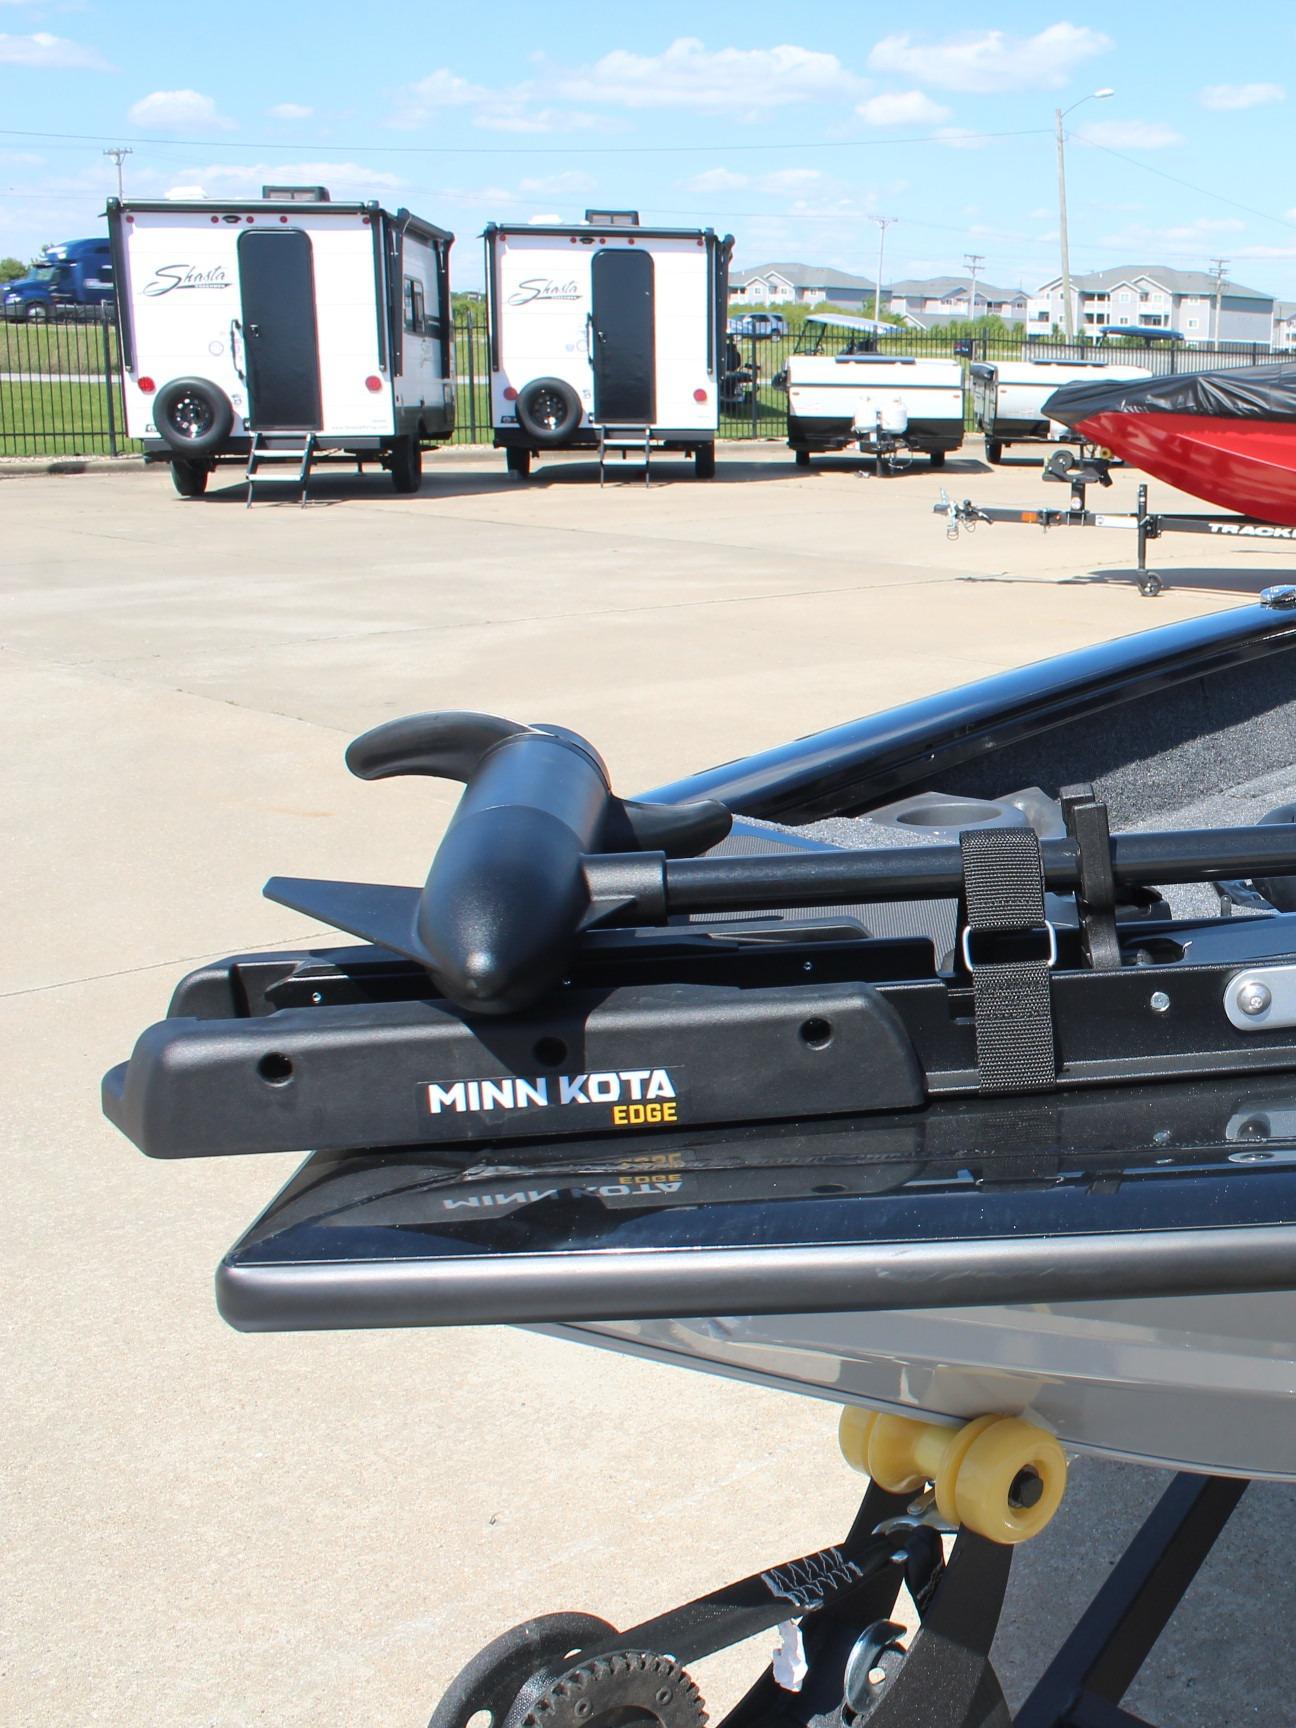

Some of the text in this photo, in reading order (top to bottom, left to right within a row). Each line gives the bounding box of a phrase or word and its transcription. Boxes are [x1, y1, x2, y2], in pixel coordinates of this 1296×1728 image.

[142, 264, 226, 297] Shasta
[507, 278, 578, 306] Shasta
[427, 1069, 677, 1114] MINN KOTA
[612, 1102, 678, 1126] EDGE
